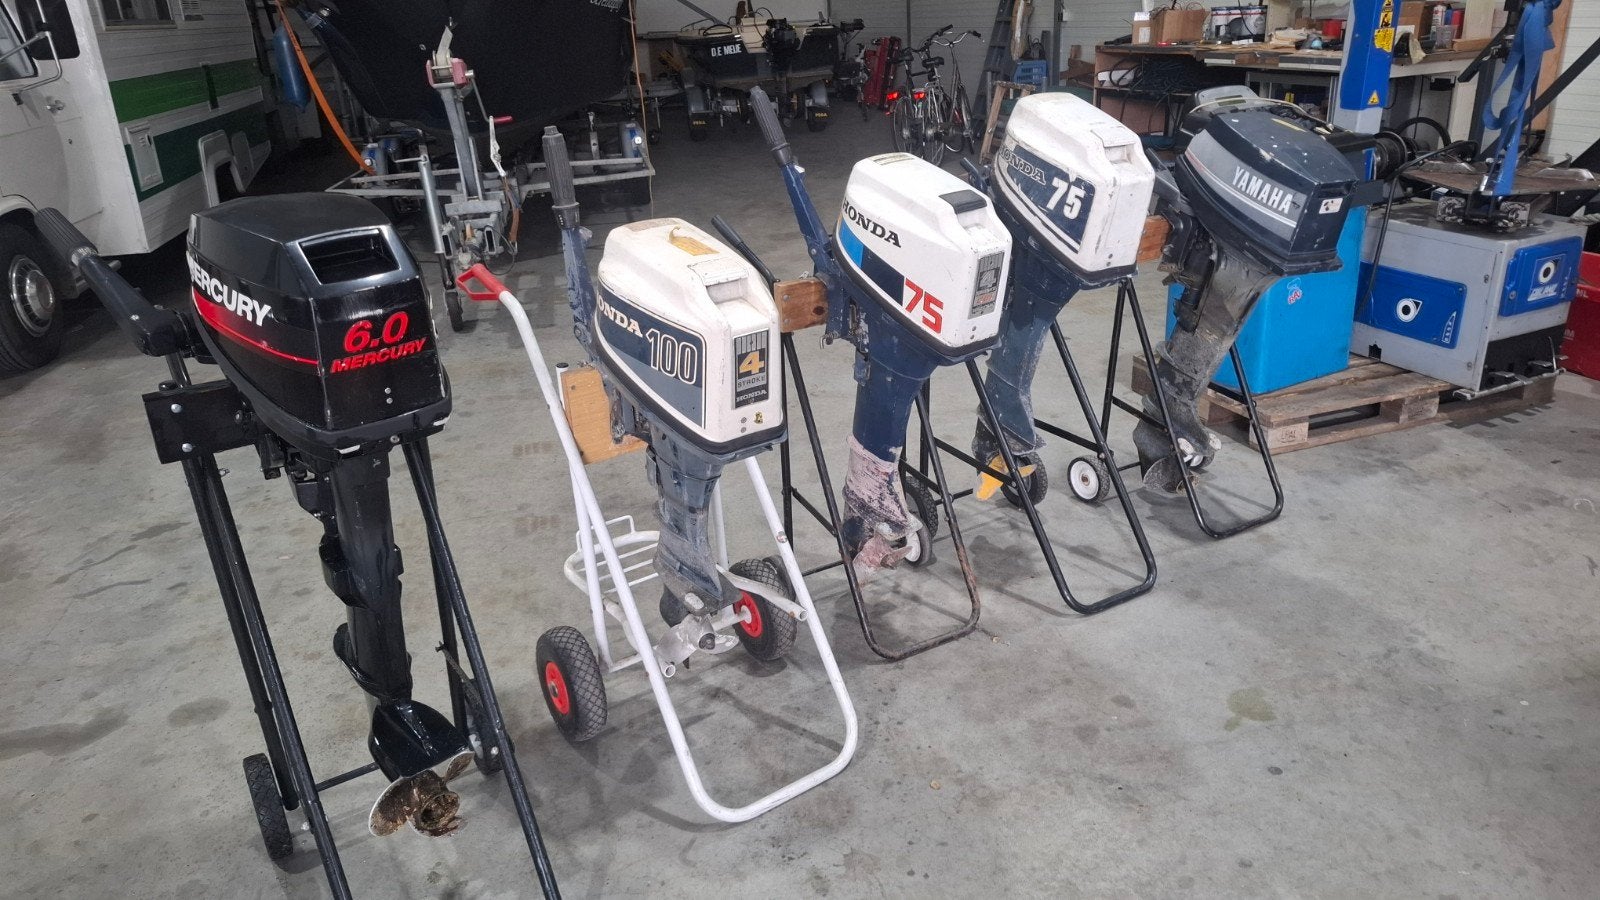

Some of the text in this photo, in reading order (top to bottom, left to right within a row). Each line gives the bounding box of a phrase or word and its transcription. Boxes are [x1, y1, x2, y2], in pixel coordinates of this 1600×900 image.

[1046, 176, 1085, 220] 75
[1232, 166, 1293, 214] YAMAHA
[843, 198, 901, 248] HONDA
[186, 251, 272, 327] MERCURY
[904, 278, 944, 334] 75
[344, 311, 409, 352] 6.0
[597, 294, 697, 385] ONDA 100
[331, 338, 426, 373] MERCURY
[739, 351, 765, 376] 4
[736, 390, 767, 402] HONDA
[737, 375, 766, 388] STROKE
